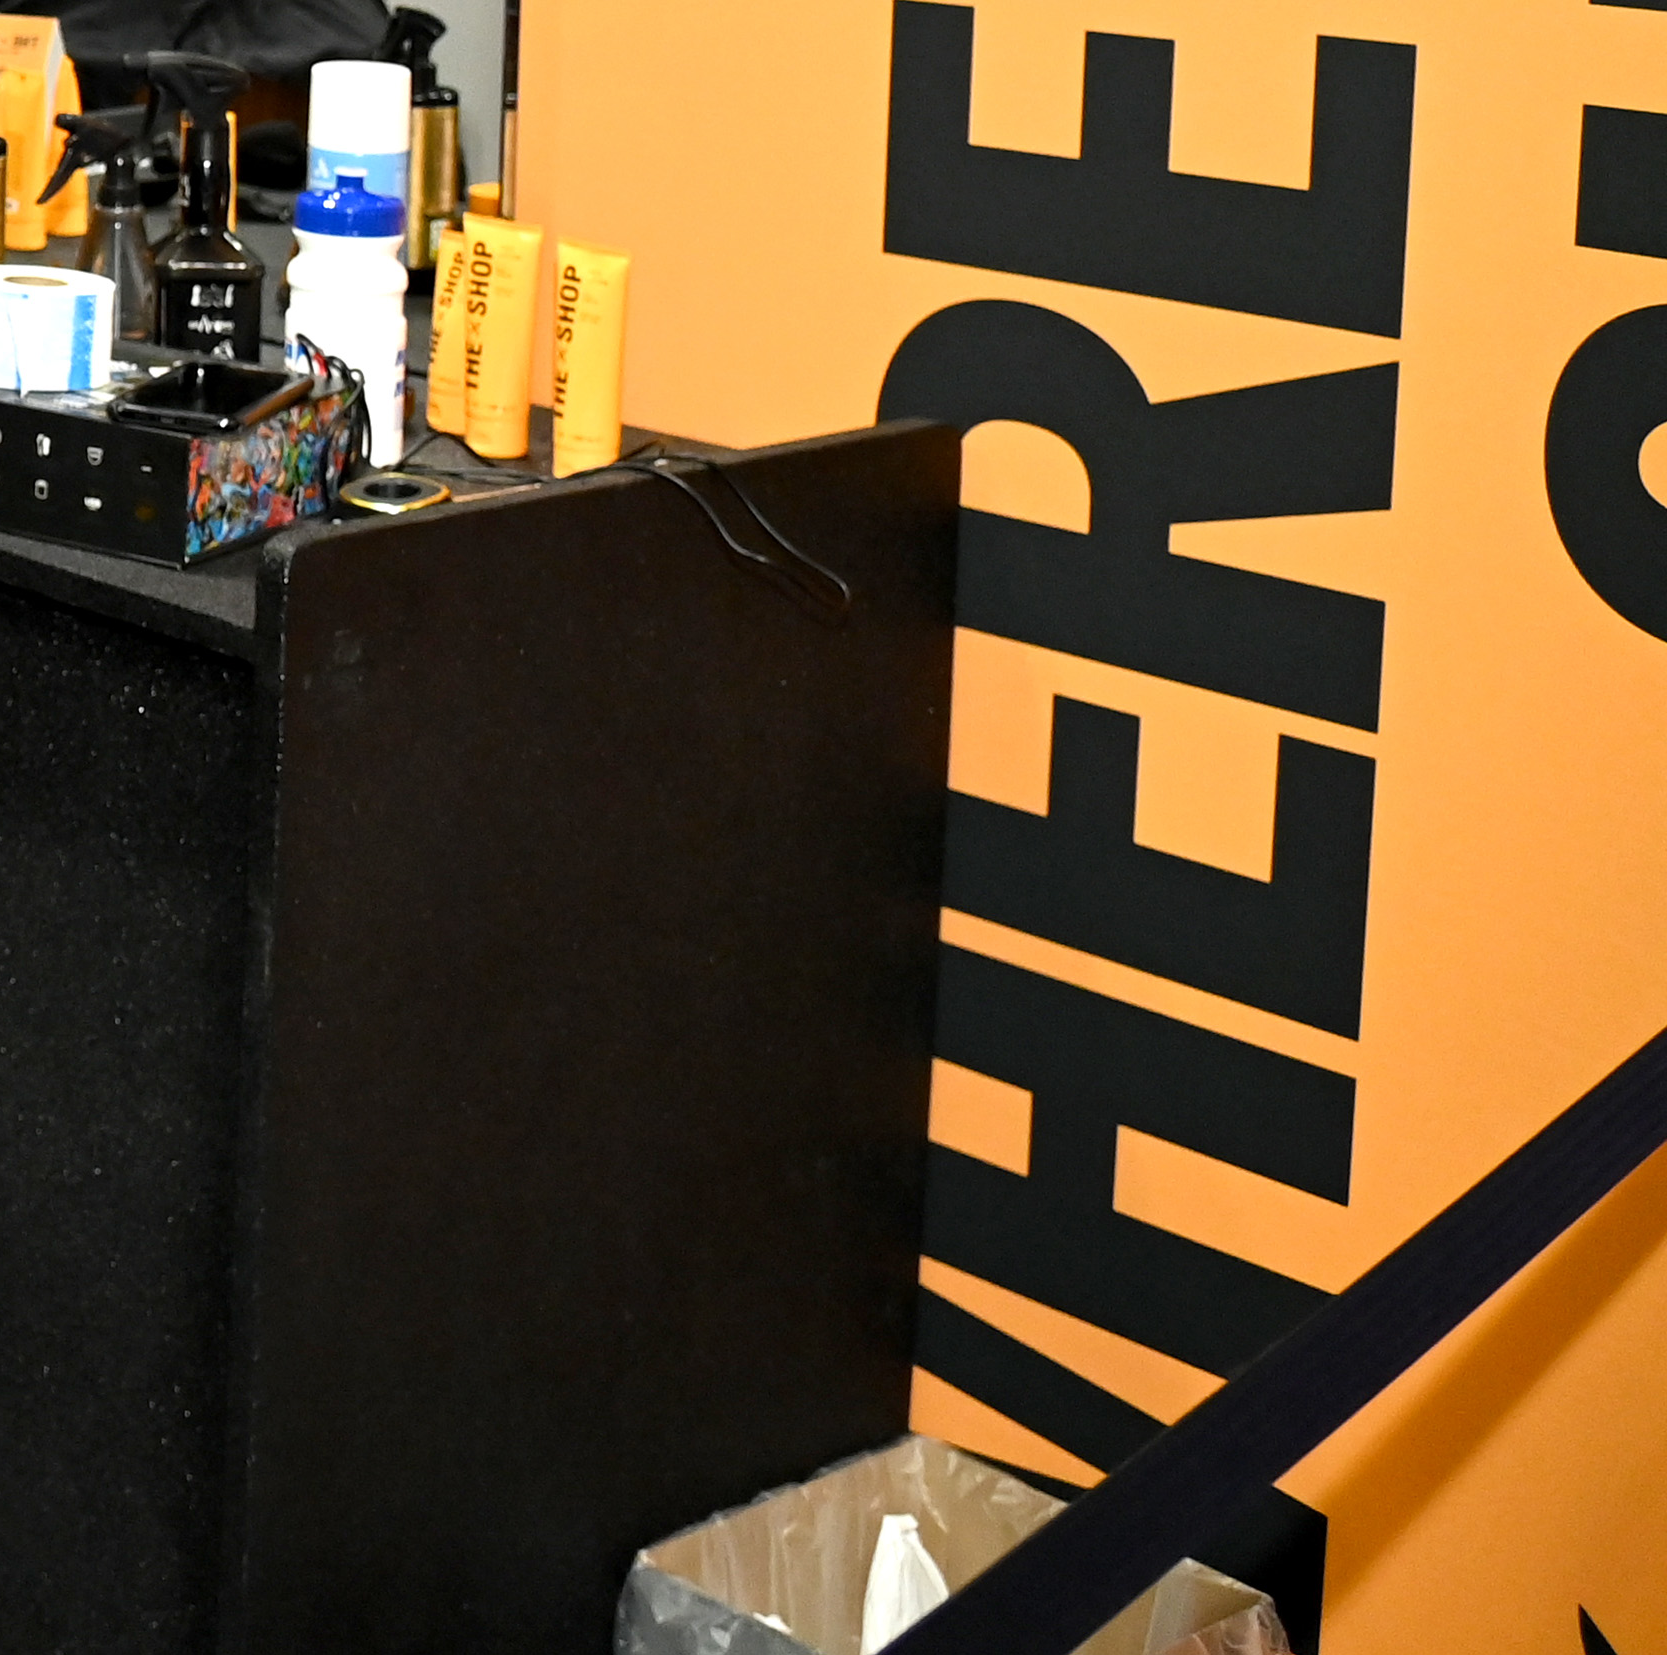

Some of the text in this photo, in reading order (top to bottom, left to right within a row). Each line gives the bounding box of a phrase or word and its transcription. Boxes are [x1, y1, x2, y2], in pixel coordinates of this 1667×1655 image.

[439, 251, 465, 308] SHOP
[468, 240, 494, 317] SHOP
[556, 264, 582, 343] SHOP
